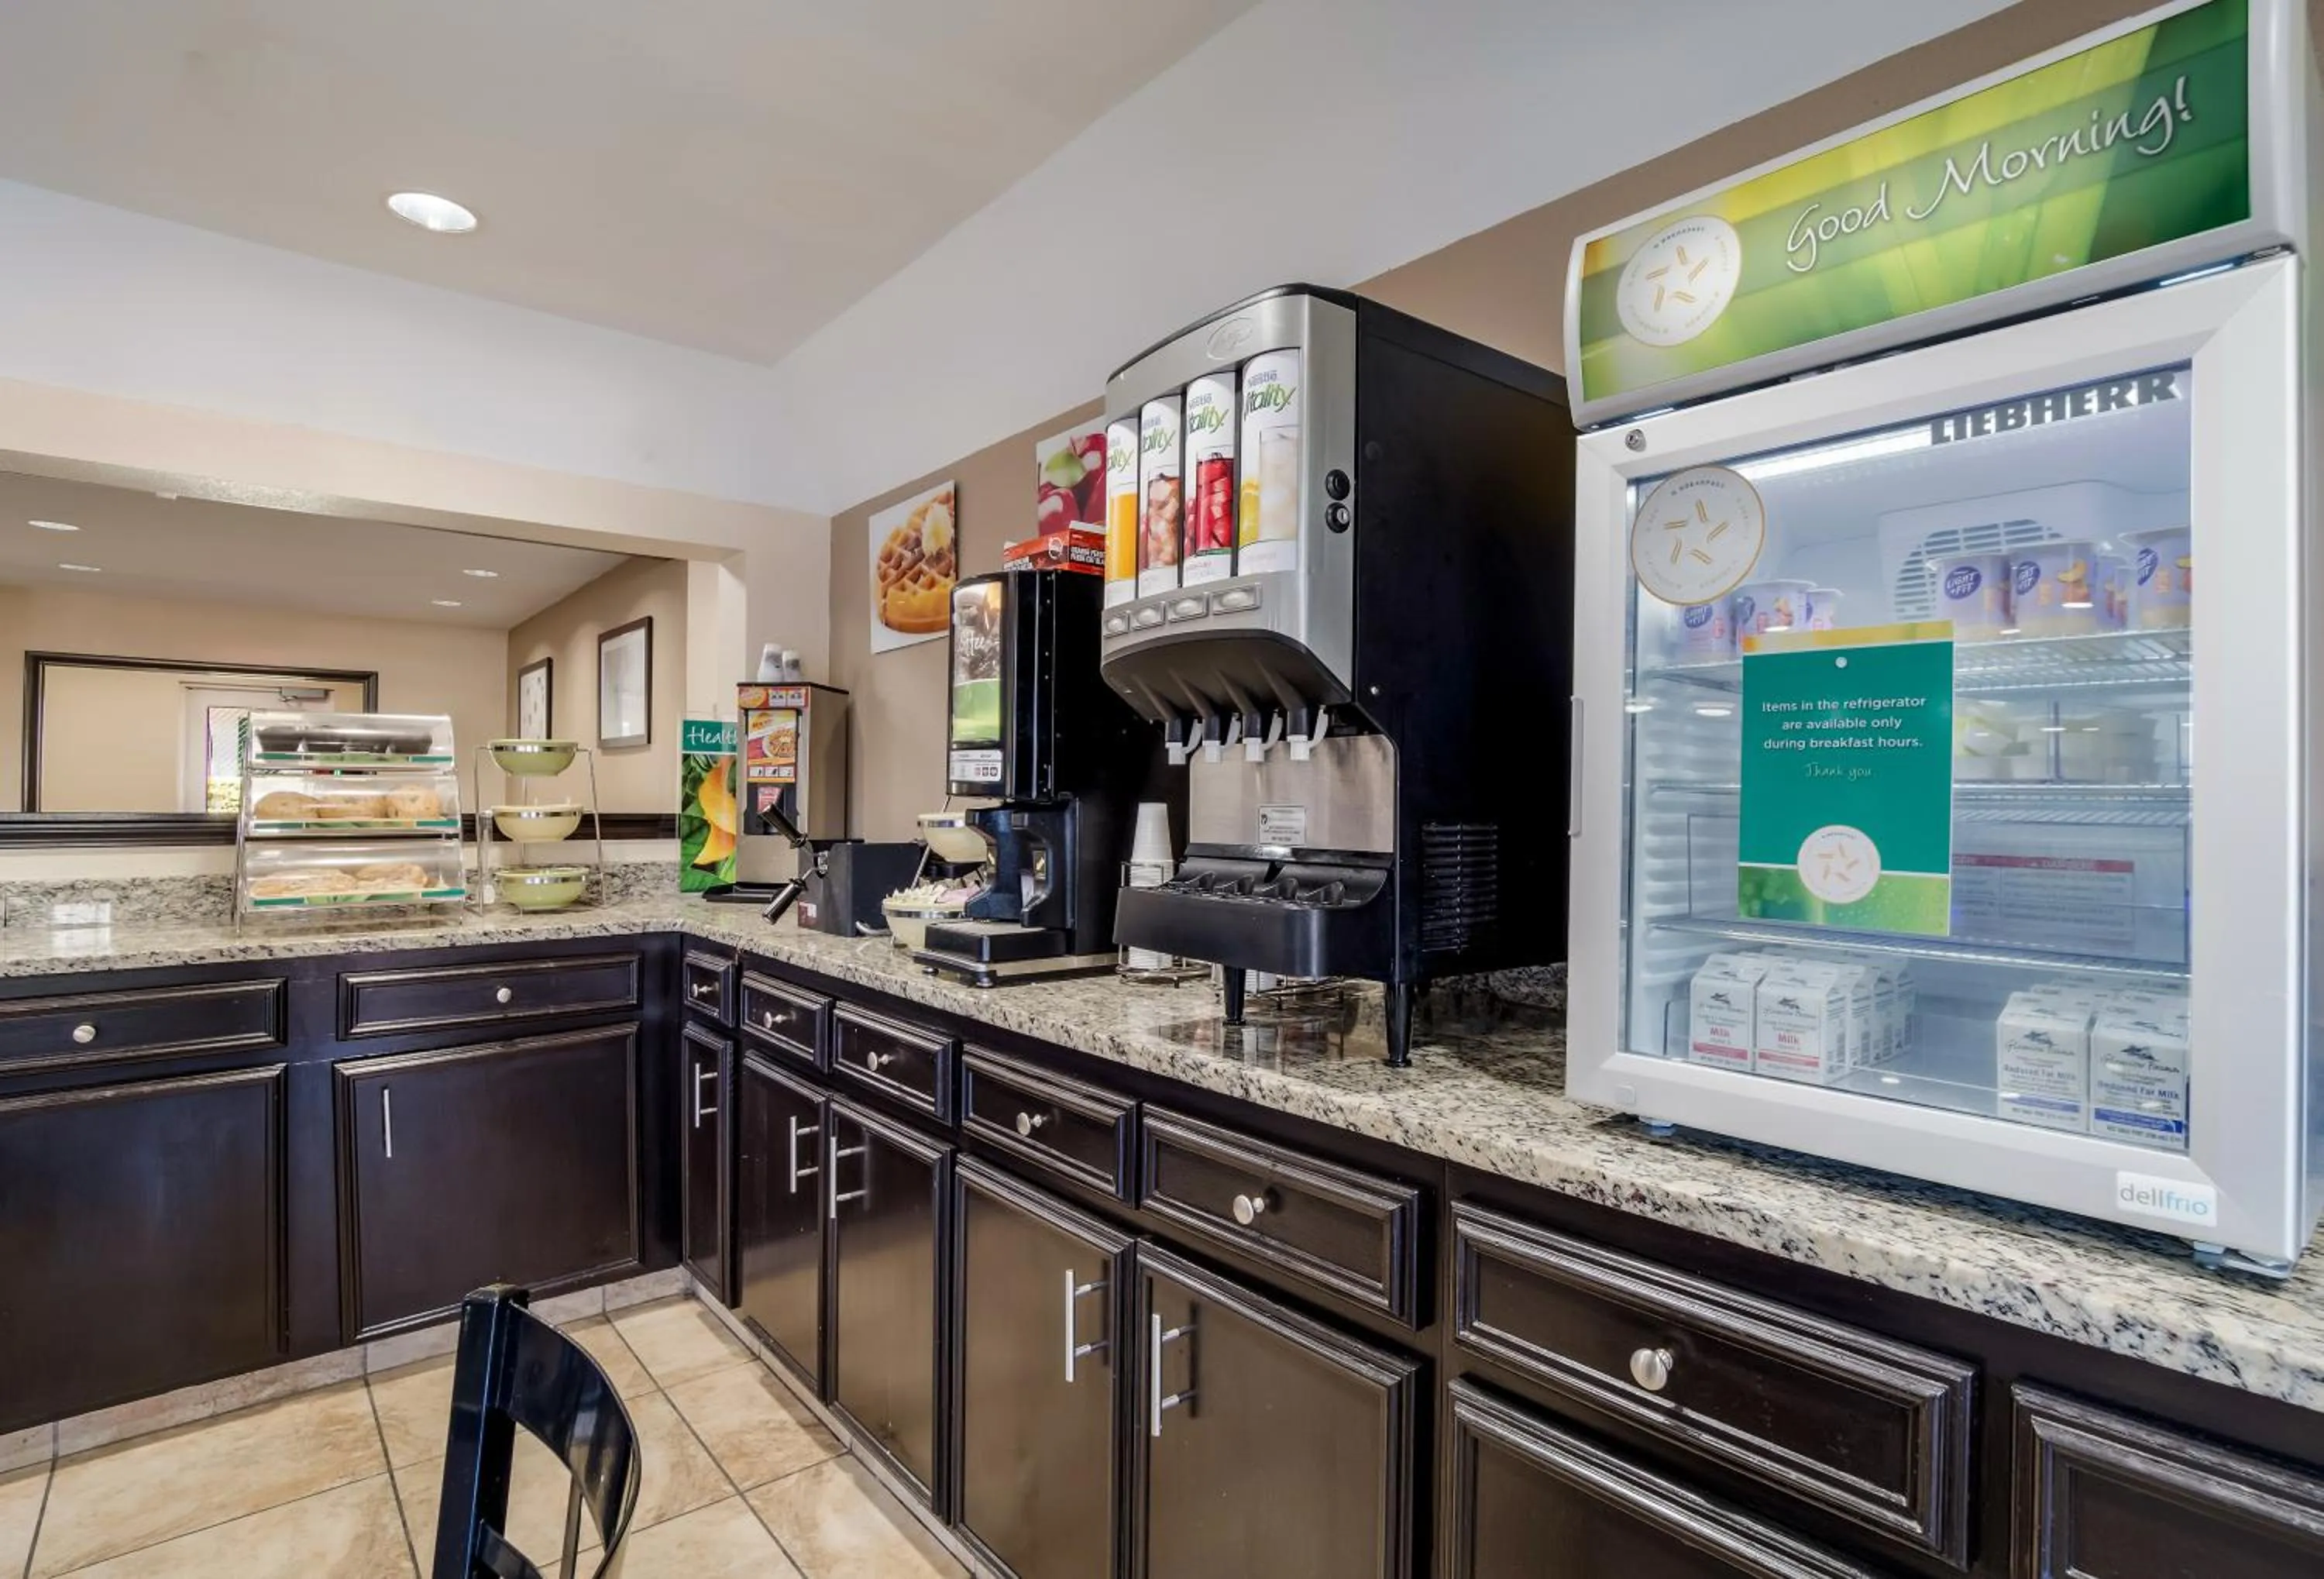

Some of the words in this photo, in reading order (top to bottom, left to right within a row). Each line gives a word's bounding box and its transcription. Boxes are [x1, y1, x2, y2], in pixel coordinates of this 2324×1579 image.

[1786, 181, 1891, 273] Good
[1905, 75, 2194, 221] Morning!
[1930, 373, 2184, 447] LIEBHERR
[1762, 700, 1798, 713] Items
[1801, 700, 1813, 711] in
[1817, 698, 1839, 711] the
[1843, 697, 1927, 711] refrigerator
[1783, 720, 1803, 731] are
[1806, 717, 1867, 730] available
[1871, 716, 1903, 729] only
[1763, 738, 1807, 751] during
[1810, 736, 1875, 749] breakfast
[1878, 735, 1924, 748] hours.
[1803, 762, 1843, 777] Thank
[1848, 769, 1872, 782] you
[2119, 1184, 2209, 1216] dellfrio
